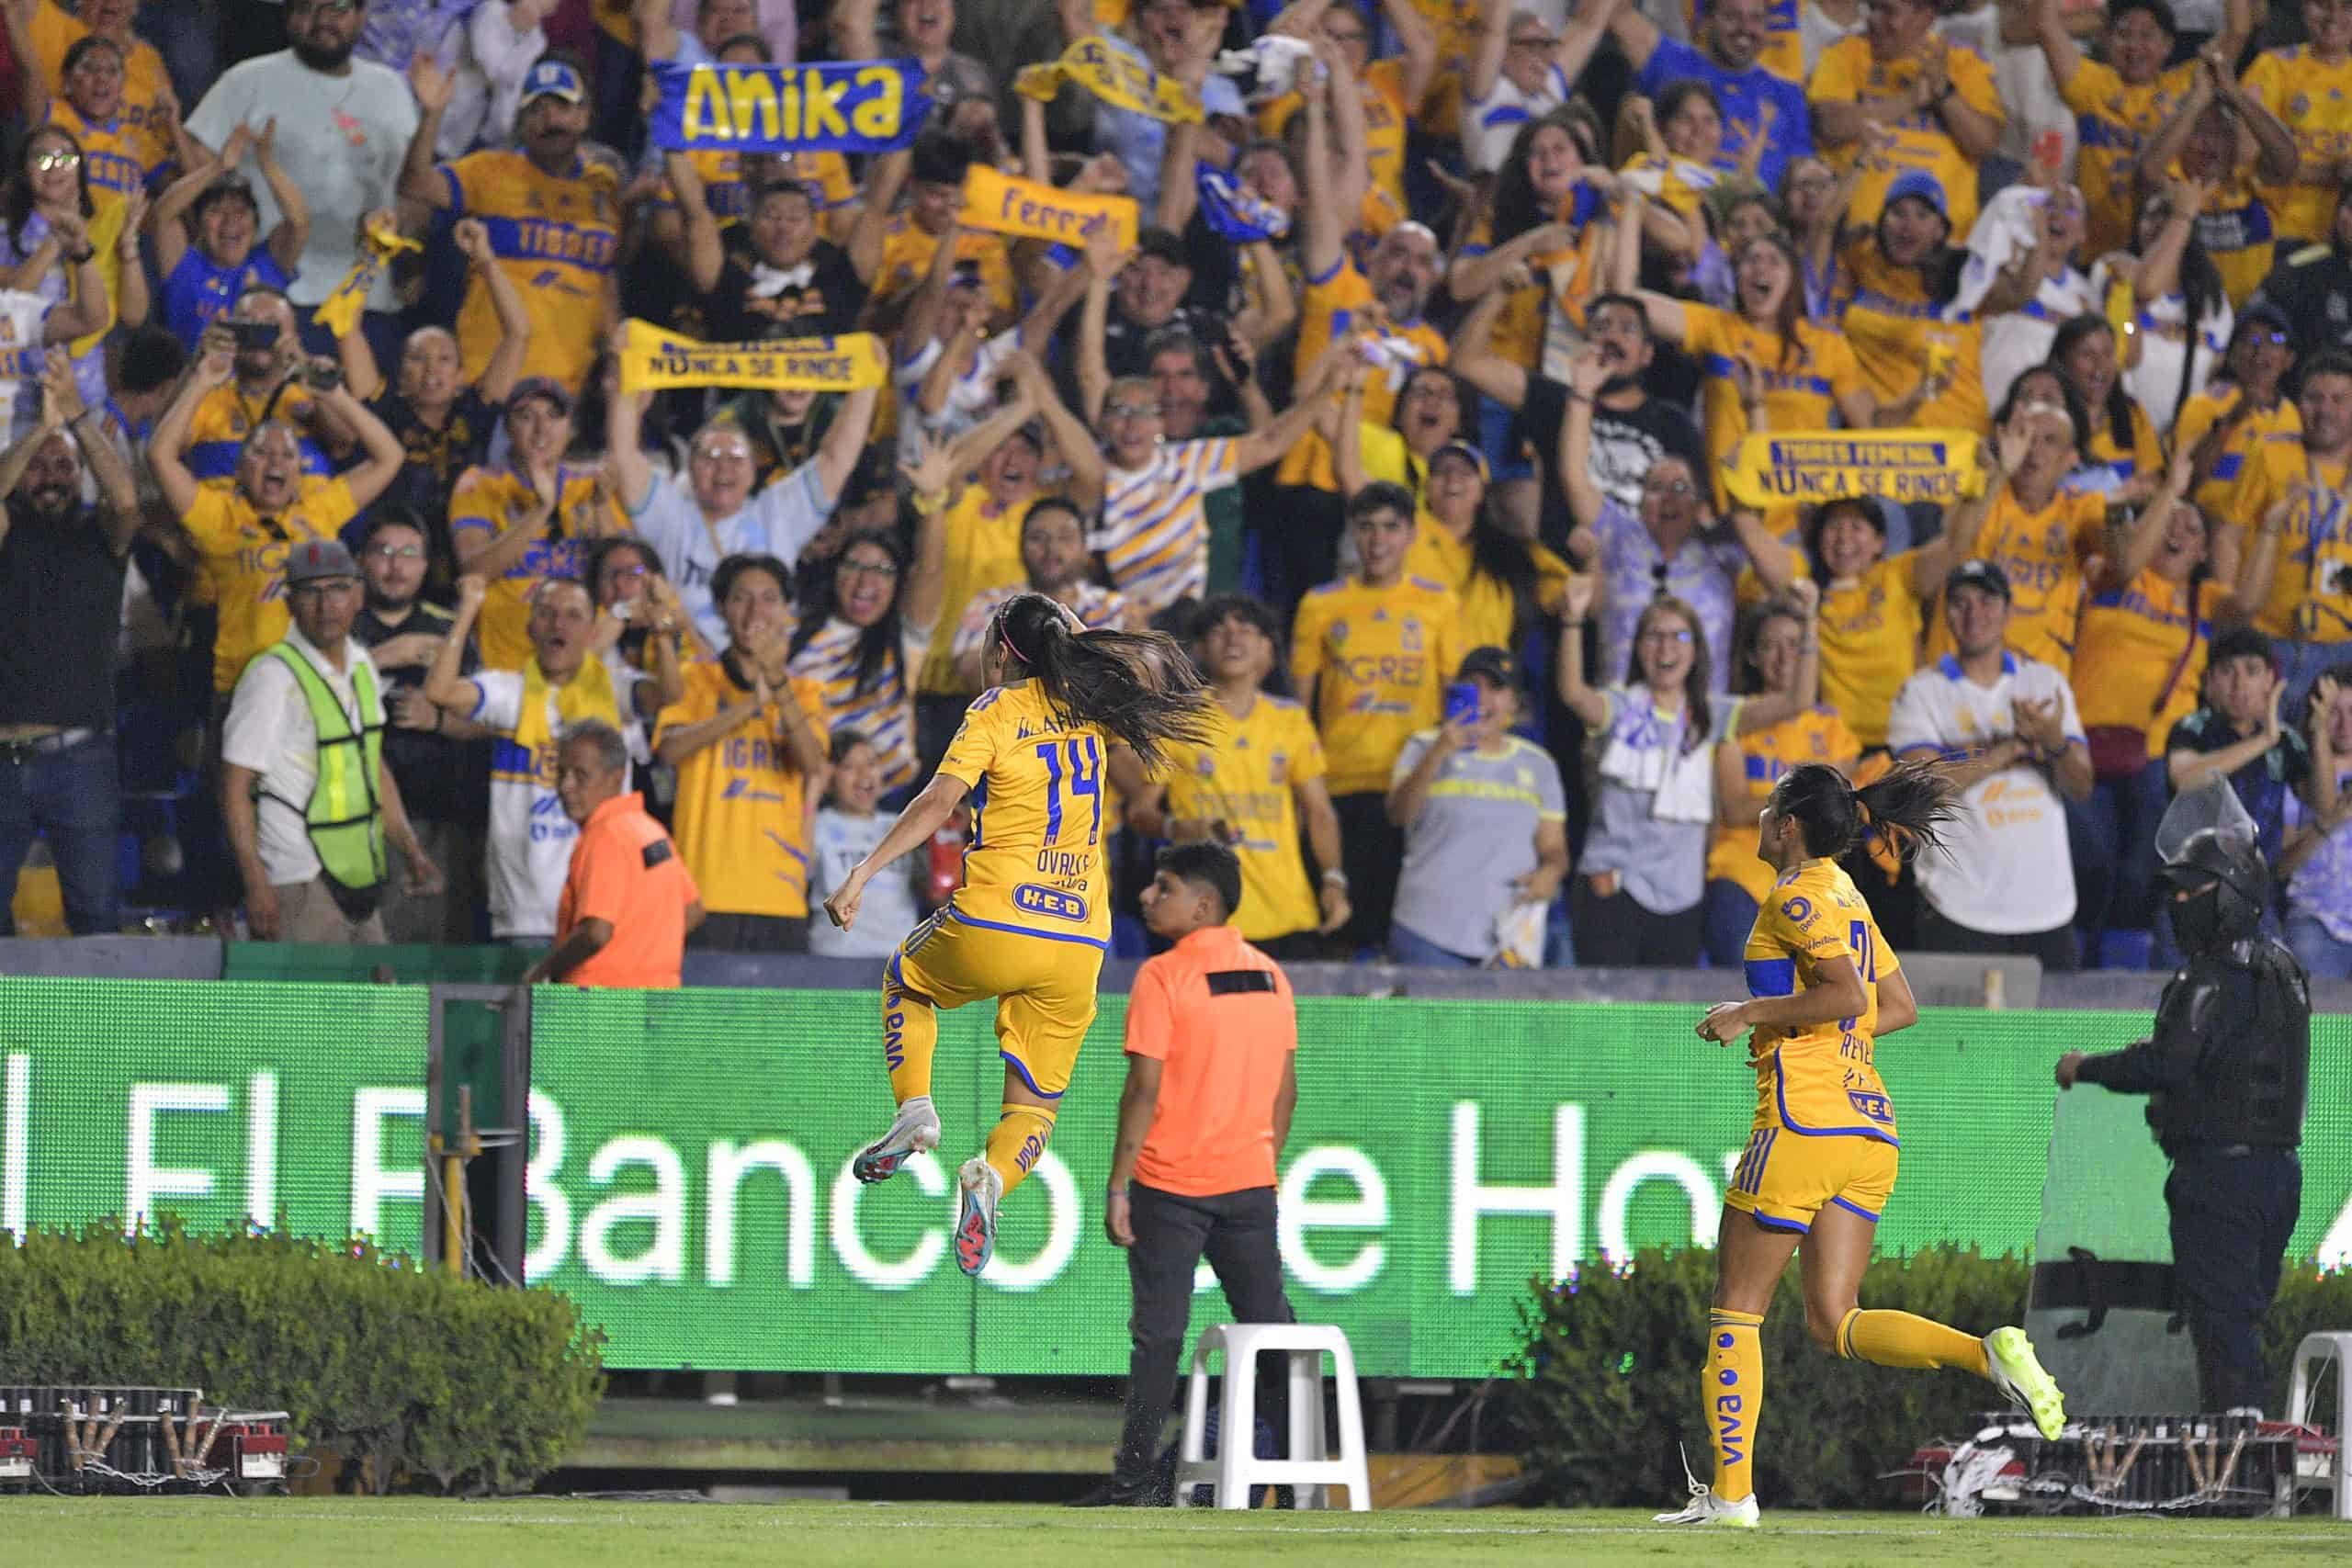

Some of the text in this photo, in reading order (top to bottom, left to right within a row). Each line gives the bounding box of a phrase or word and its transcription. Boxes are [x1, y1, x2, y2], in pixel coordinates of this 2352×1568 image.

[683, 62, 903, 140] Anika
[650, 355, 739, 375] NUNCA
[749, 356, 775, 378] SE
[1758, 469, 1847, 495] NUNCA
[1035, 735, 1102, 846] 14
[1839, 1032, 1873, 1066] REYE
[1450, 1098, 1743, 1298] Ho
[1717, 1394, 1744, 1467] viva
